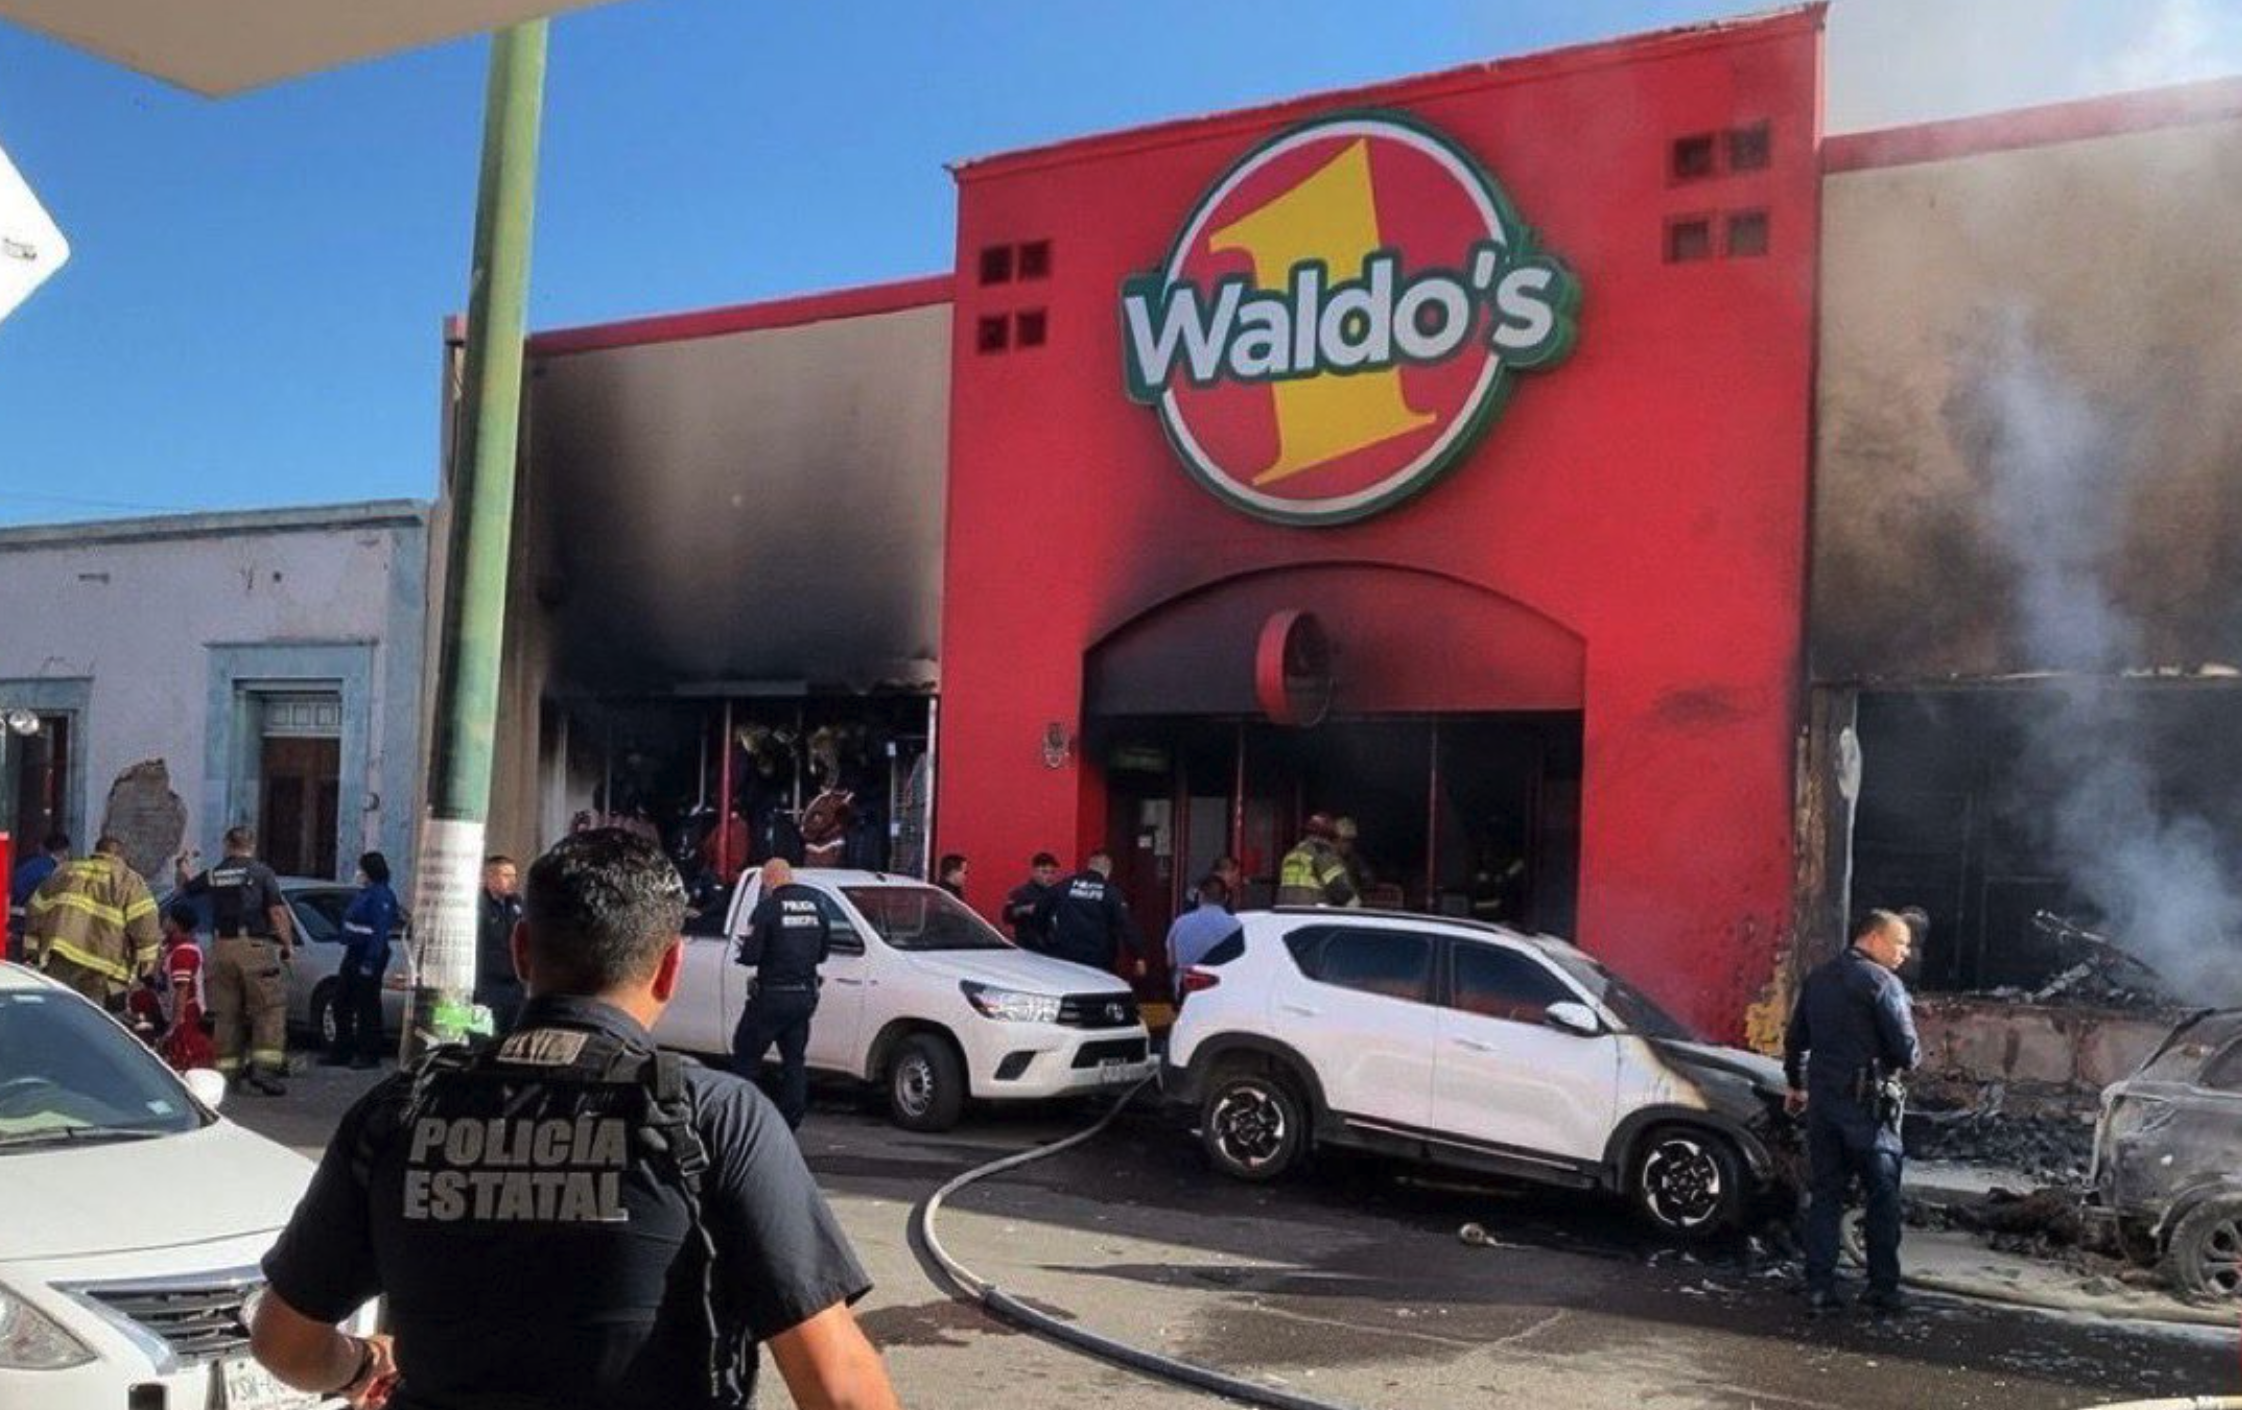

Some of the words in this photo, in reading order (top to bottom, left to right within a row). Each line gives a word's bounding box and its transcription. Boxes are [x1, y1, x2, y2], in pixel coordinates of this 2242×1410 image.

[1123, 250, 1554, 386] Waldo's
[408, 1110, 628, 1167] POLICÍA
[402, 1168, 629, 1222] ESTATAL
